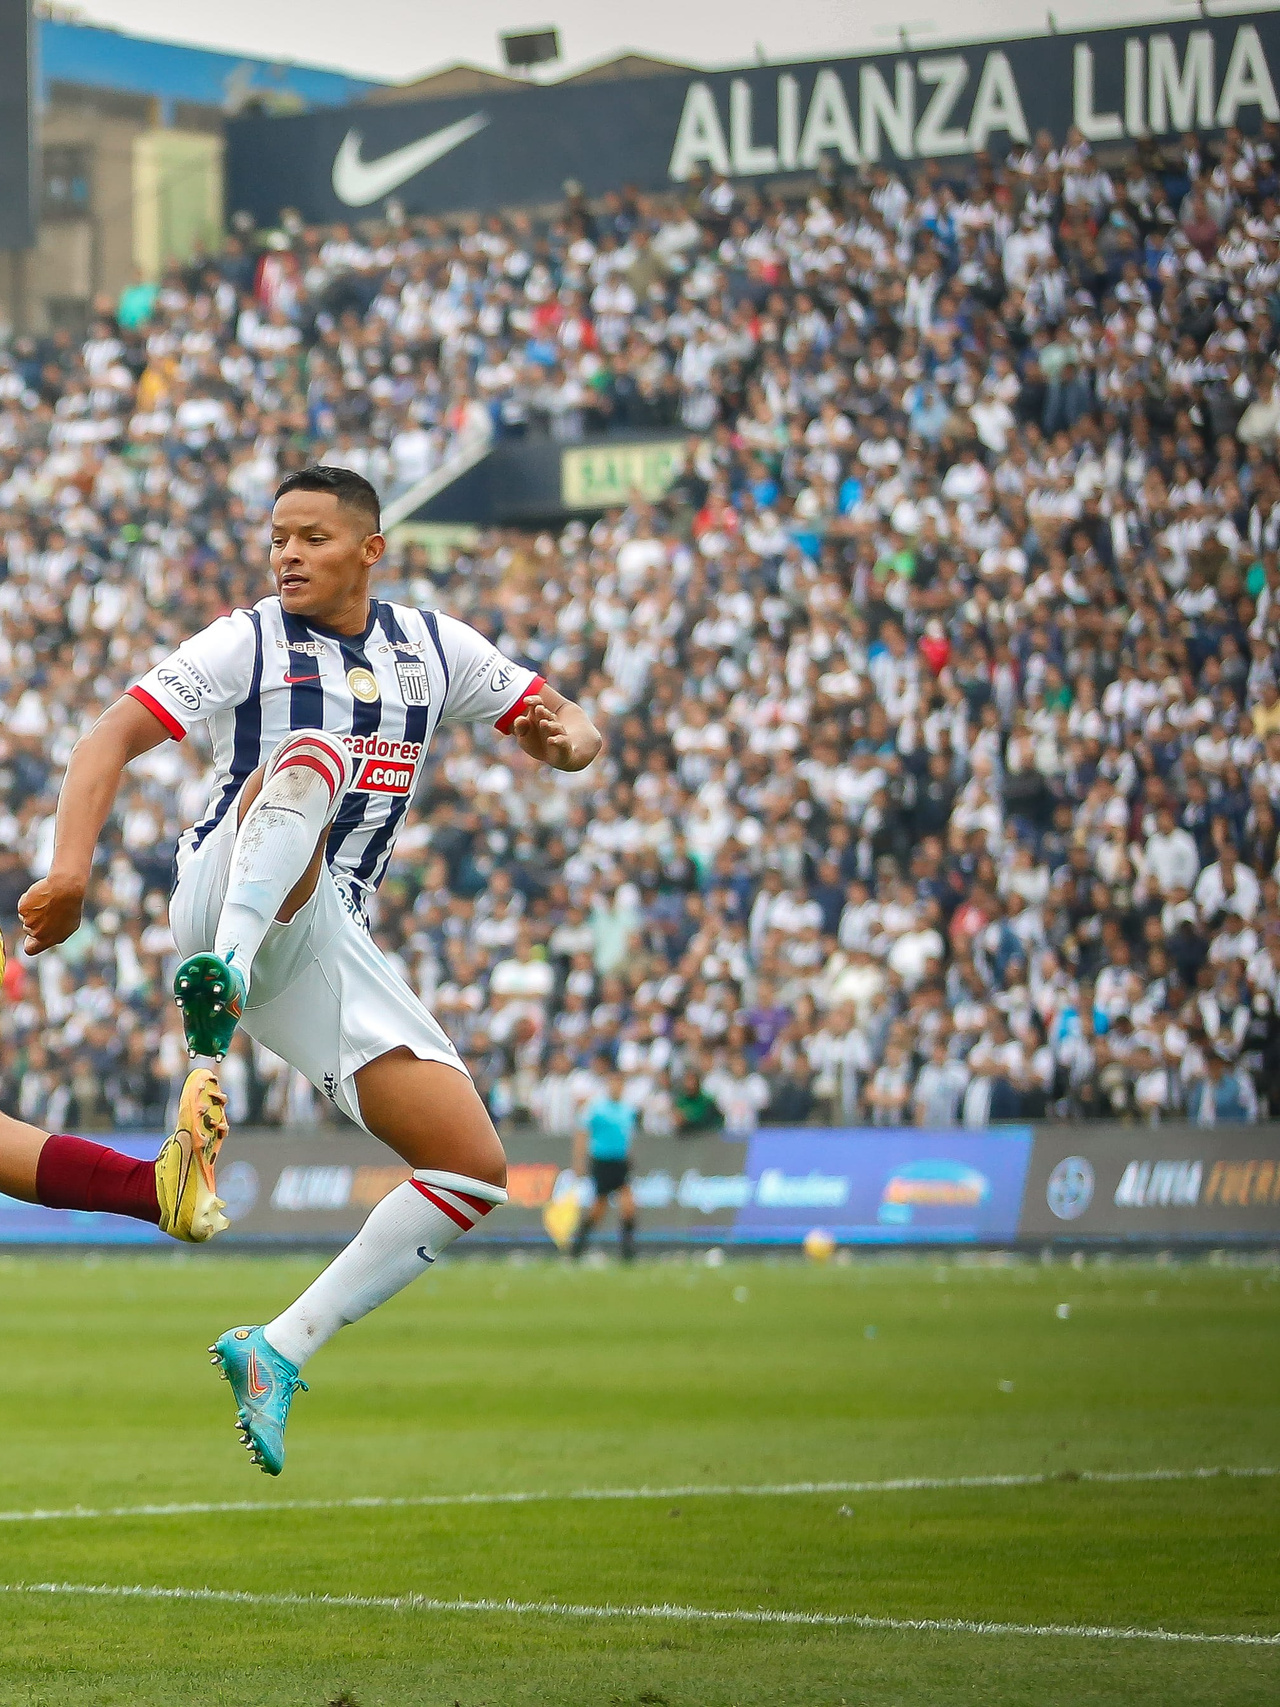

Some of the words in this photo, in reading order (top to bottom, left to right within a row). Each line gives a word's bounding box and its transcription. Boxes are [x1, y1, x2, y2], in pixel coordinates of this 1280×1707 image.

[668, 49, 1030, 183] ALIANZA
[1073, 23, 1280, 142] LIMA
[276, 640, 327, 652] GLORY
[378, 640, 423, 654] GLRY
[338, 734, 421, 761] cadores
[366, 768, 410, 788] .com
